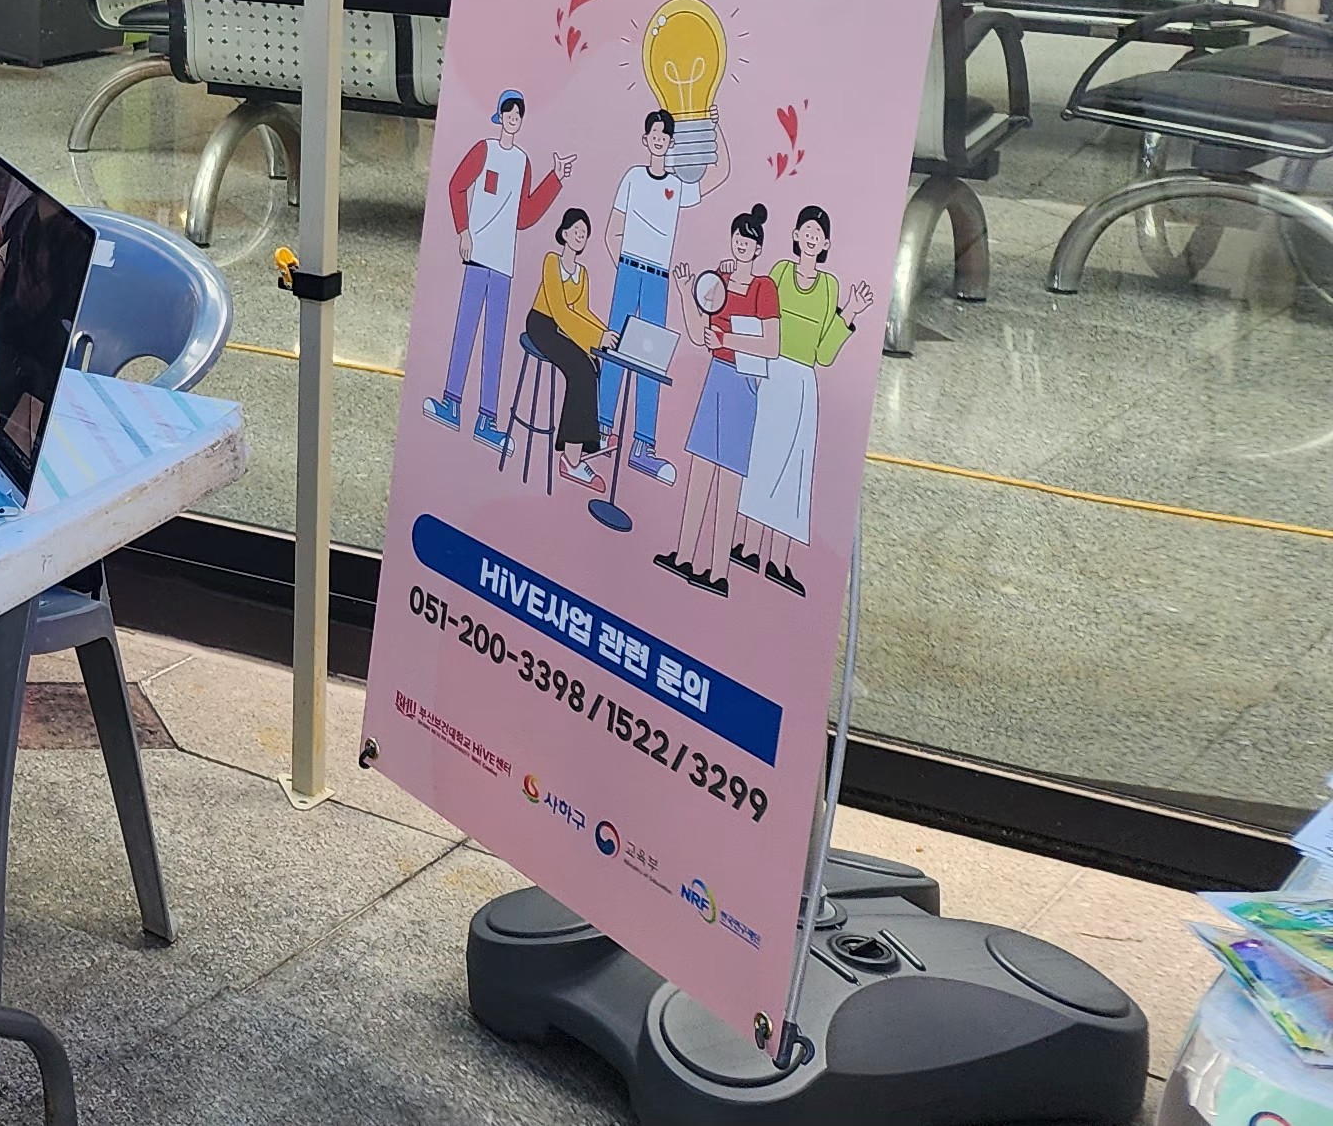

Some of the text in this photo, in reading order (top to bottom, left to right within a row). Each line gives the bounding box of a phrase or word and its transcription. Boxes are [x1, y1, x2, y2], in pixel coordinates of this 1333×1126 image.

[479, 557, 711, 713] HiVE사업 관련 문의
[472, 741, 512, 777] HiVE센터
[544, 791, 586, 830] 사하구
[625, 840, 660, 872] 교육부
[680, 883, 711, 912] NRF
